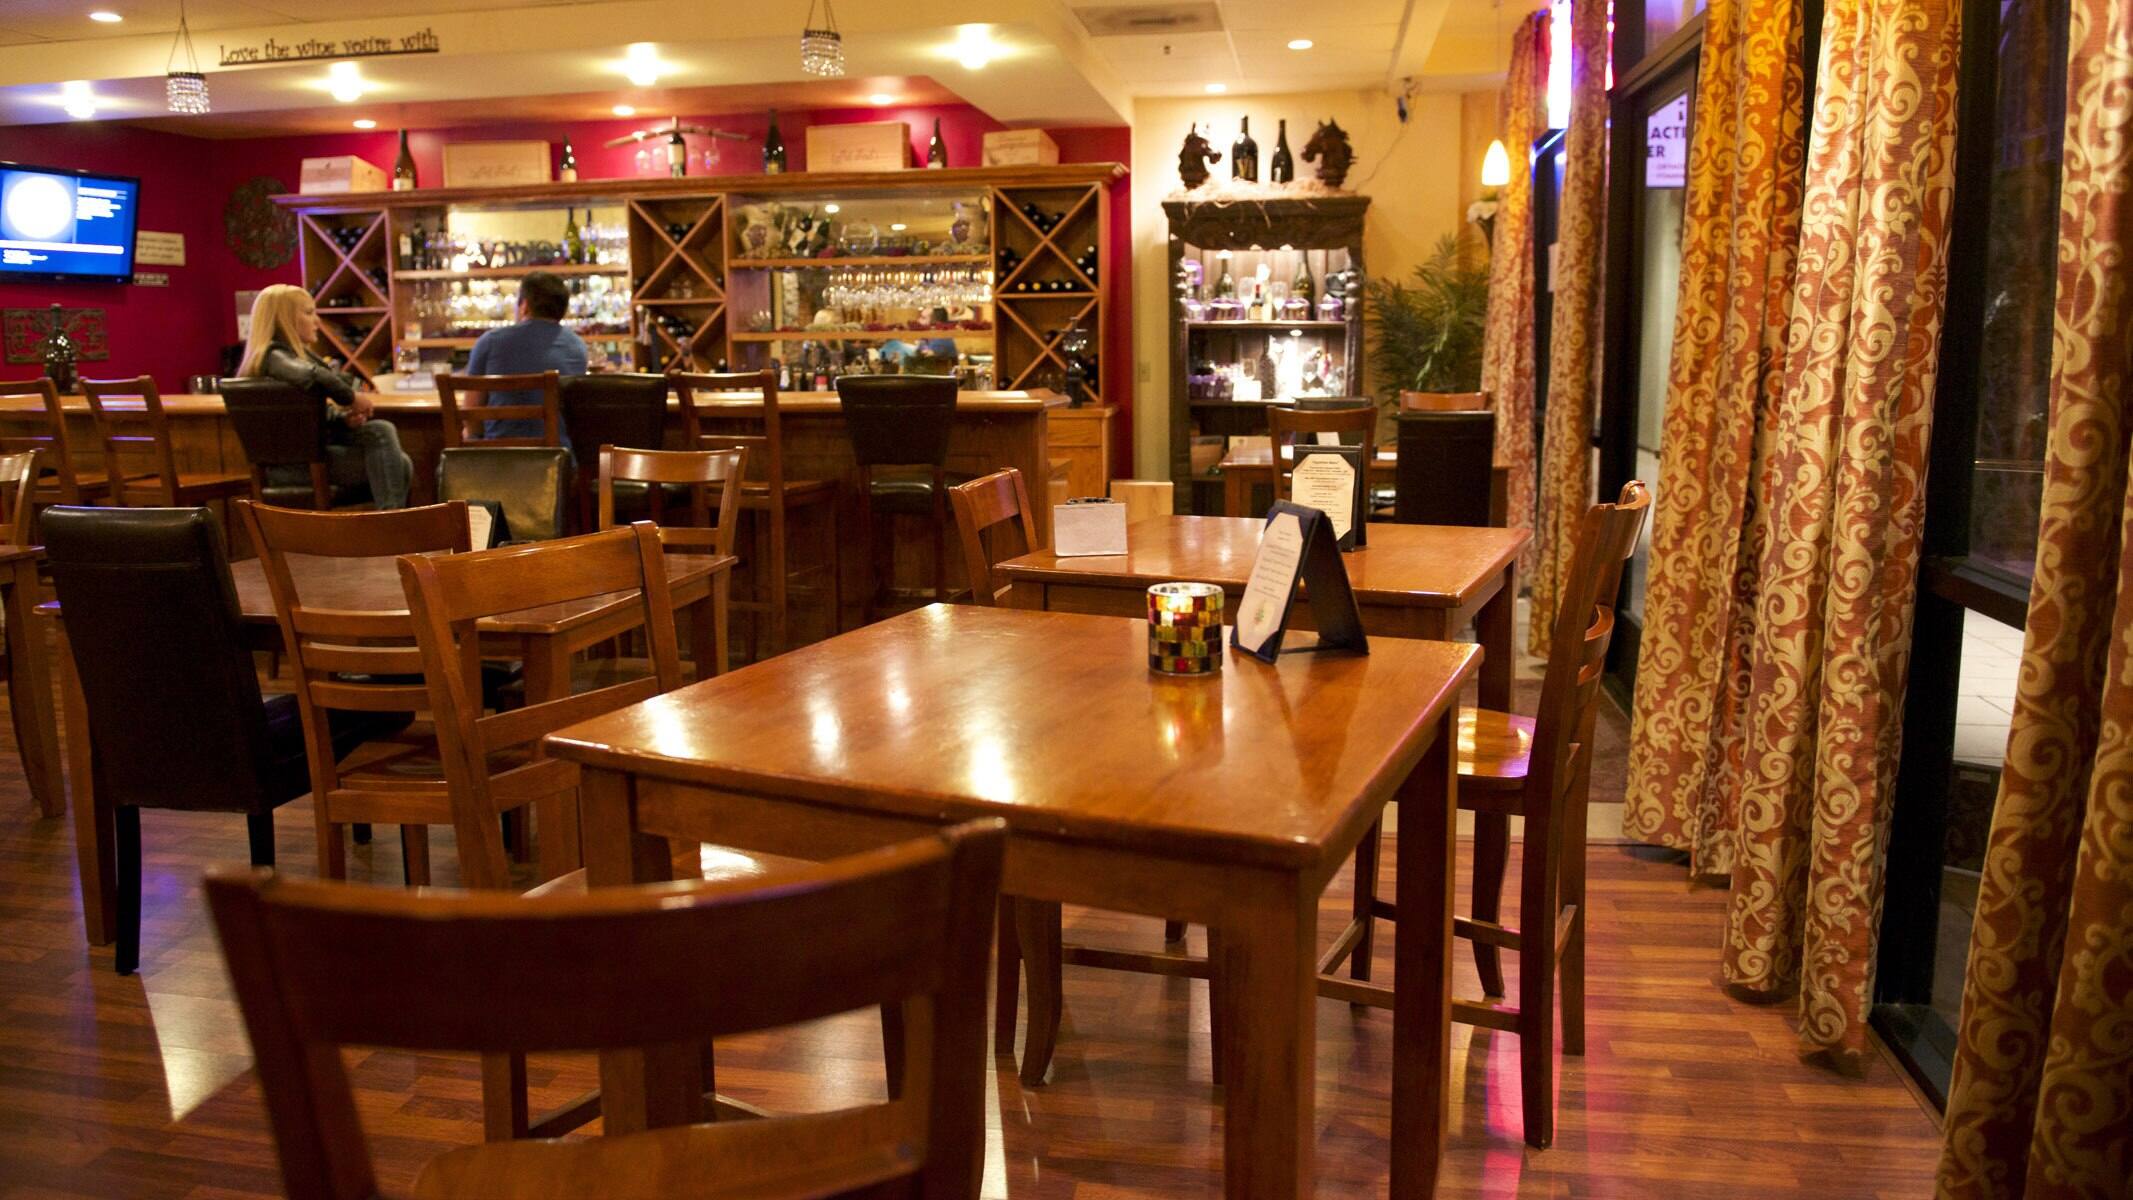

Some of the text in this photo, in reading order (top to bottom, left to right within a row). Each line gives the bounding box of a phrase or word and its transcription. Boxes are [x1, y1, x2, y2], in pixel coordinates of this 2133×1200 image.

[219, 45, 258, 64] Love
[265, 38, 289, 60] the
[296, 39, 335, 57] wine
[400, 27, 439, 50] with
